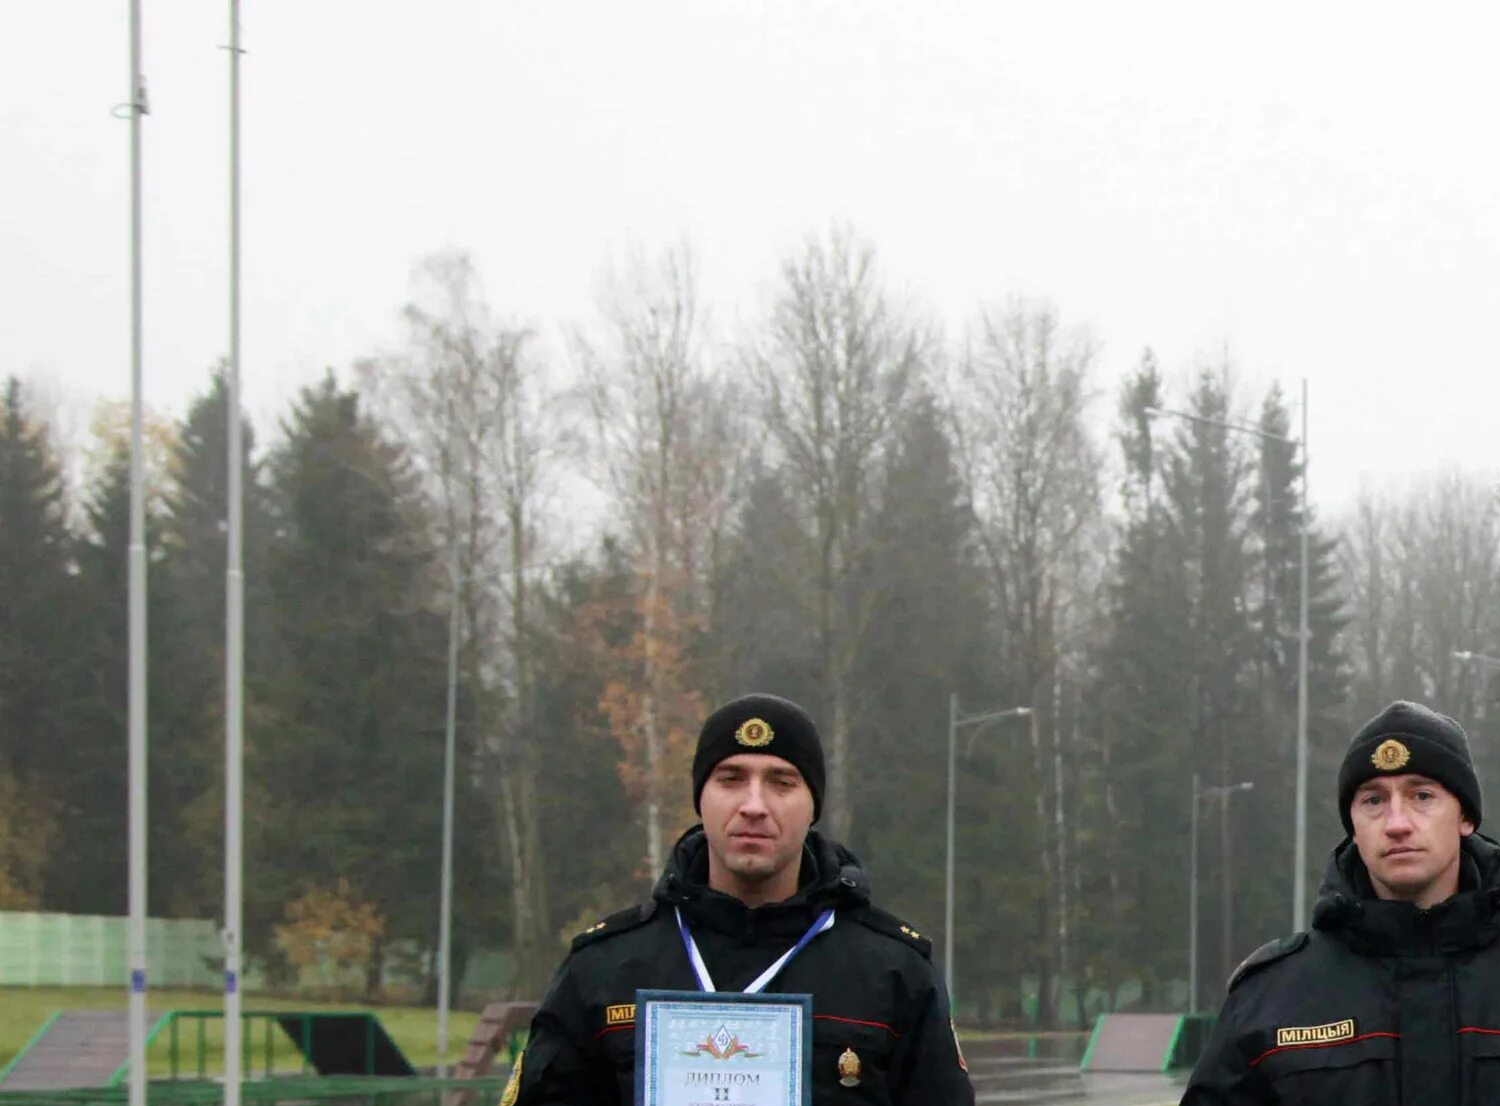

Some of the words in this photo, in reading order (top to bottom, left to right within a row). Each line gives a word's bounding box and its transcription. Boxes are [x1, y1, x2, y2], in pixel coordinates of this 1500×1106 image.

[1281, 1022, 1350, 1042] МІЛІЦЫЯ
[684, 1072, 761, 1088] ДИПЛОМ
[714, 1087, 731, 1101] II
